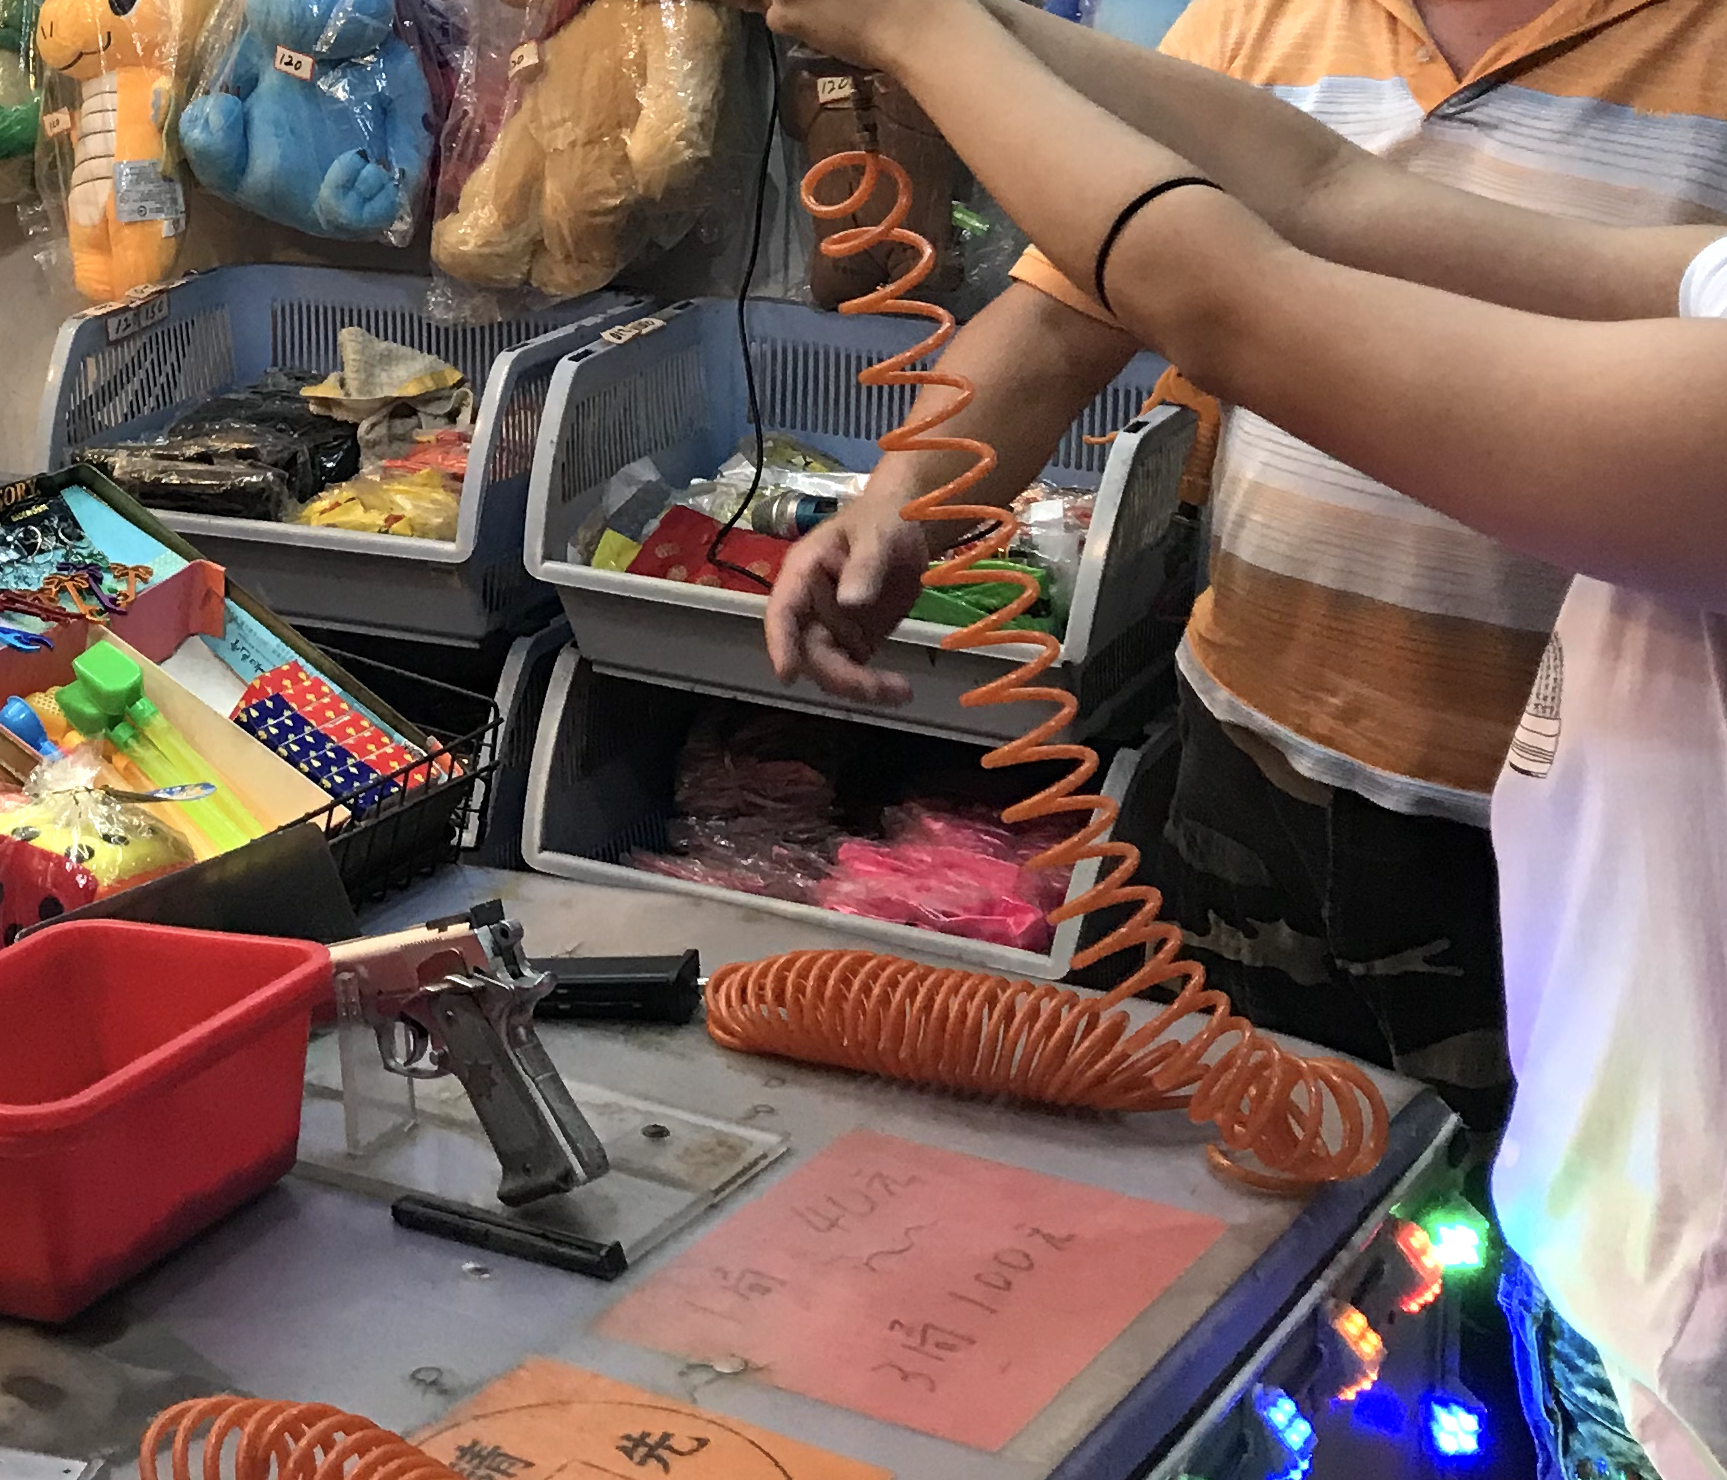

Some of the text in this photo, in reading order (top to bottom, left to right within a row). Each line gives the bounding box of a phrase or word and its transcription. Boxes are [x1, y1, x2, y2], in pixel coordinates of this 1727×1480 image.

[278, 53, 303, 72] 120
[821, 77, 849, 95] 120
[615, 1430, 711, 1476] 先
